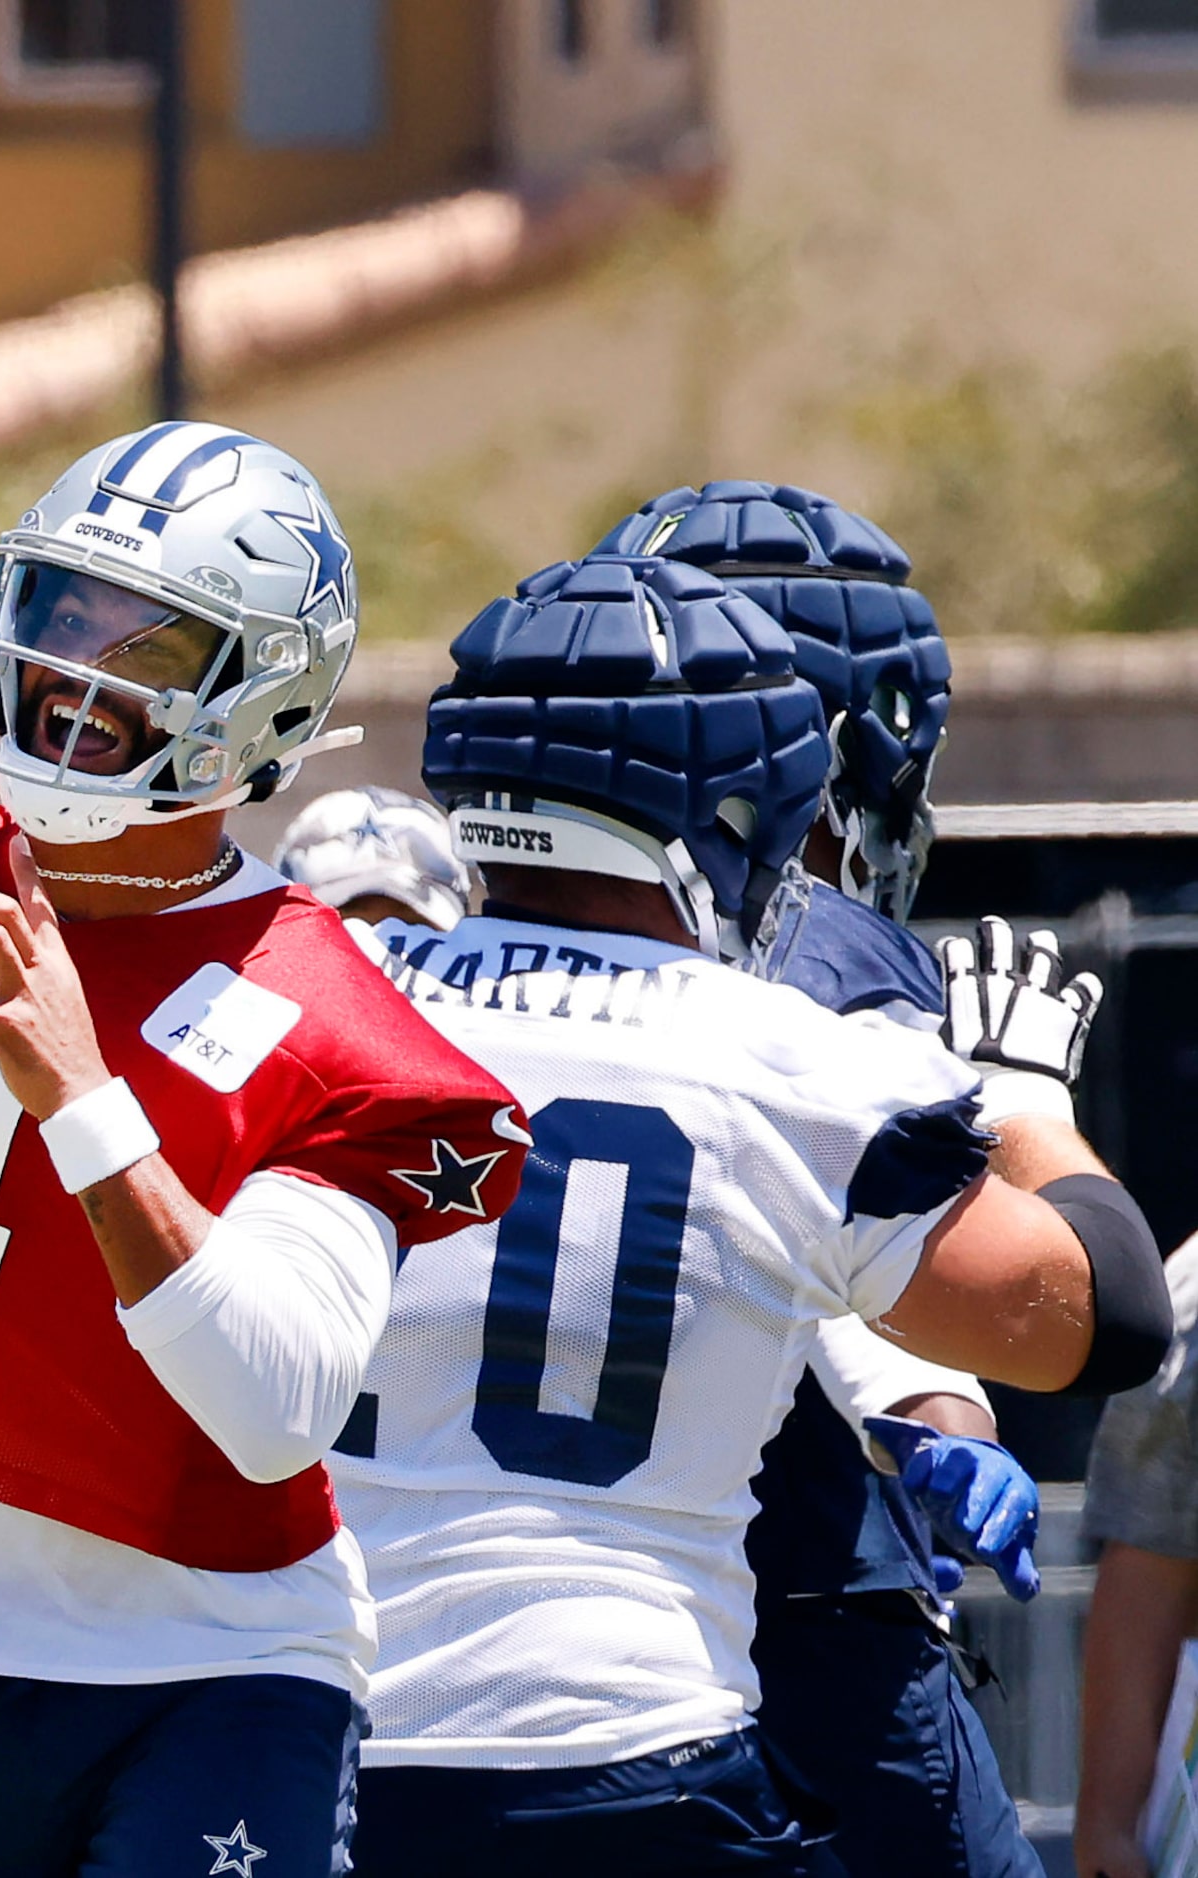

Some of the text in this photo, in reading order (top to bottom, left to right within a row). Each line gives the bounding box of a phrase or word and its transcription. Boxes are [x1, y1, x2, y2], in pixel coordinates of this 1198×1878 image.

[74, 522, 144, 552] COWBOYS
[460, 820, 554, 854] COWBOYS
[380, 934, 698, 1029] MARTIN
[167, 1023, 234, 1066] AT&T
[331, 1097, 695, 1488] 0
